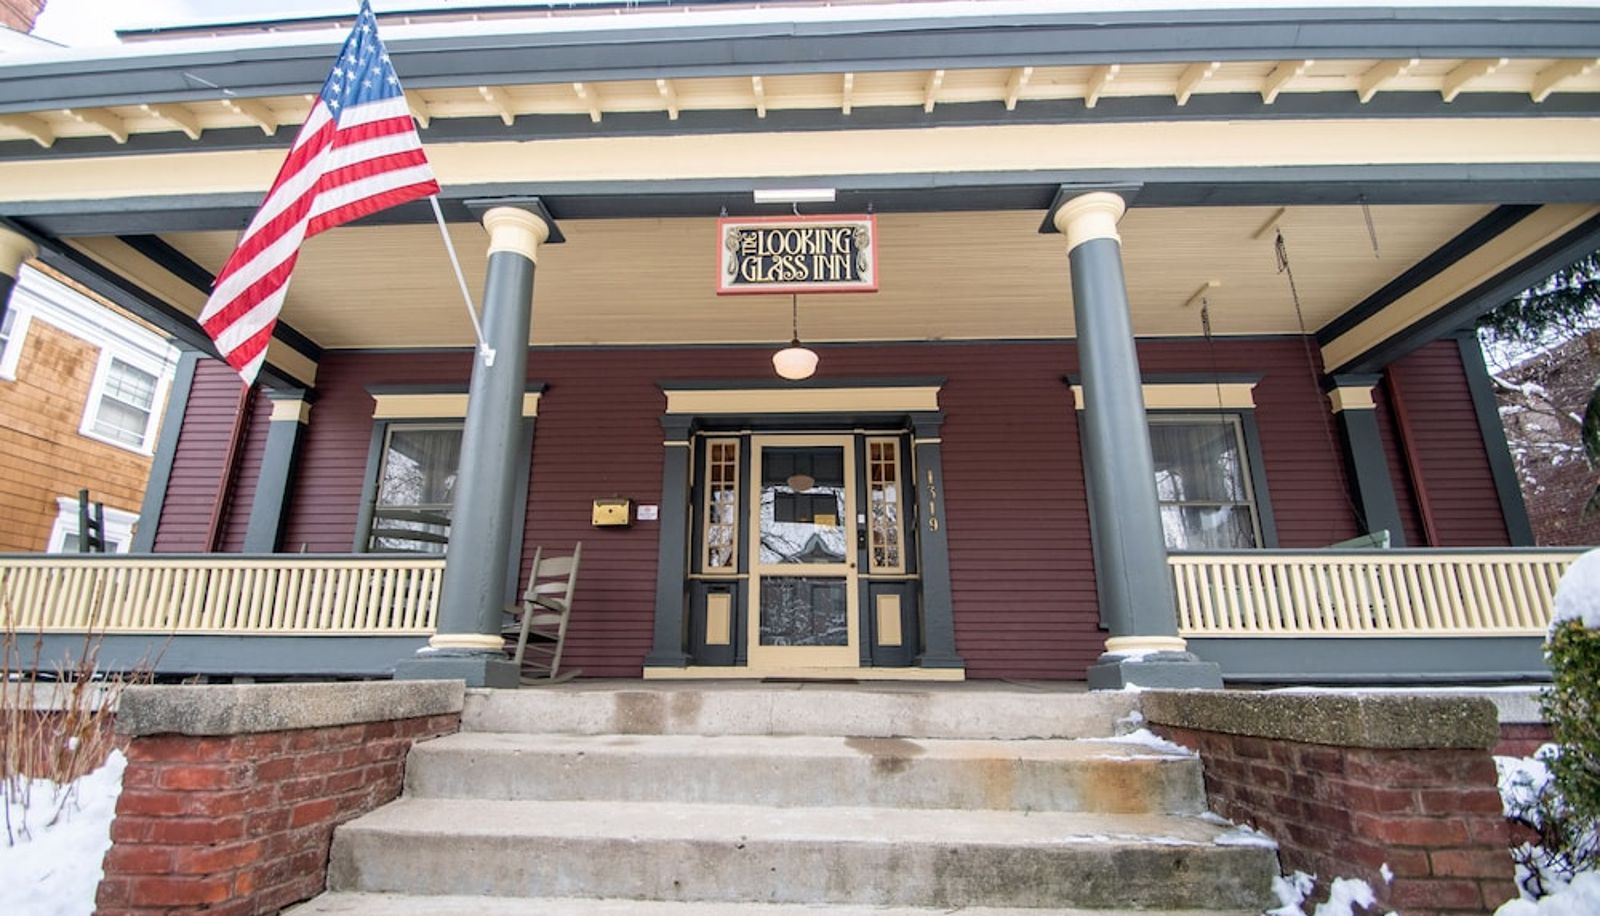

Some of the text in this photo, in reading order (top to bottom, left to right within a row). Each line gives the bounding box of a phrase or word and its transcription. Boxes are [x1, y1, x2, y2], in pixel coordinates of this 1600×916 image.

[741, 231, 758, 256] THE
[758, 228, 852, 256] LOOKING
[741, 254, 852, 282] GLASS INN
[927, 469, 939, 532] 1319
